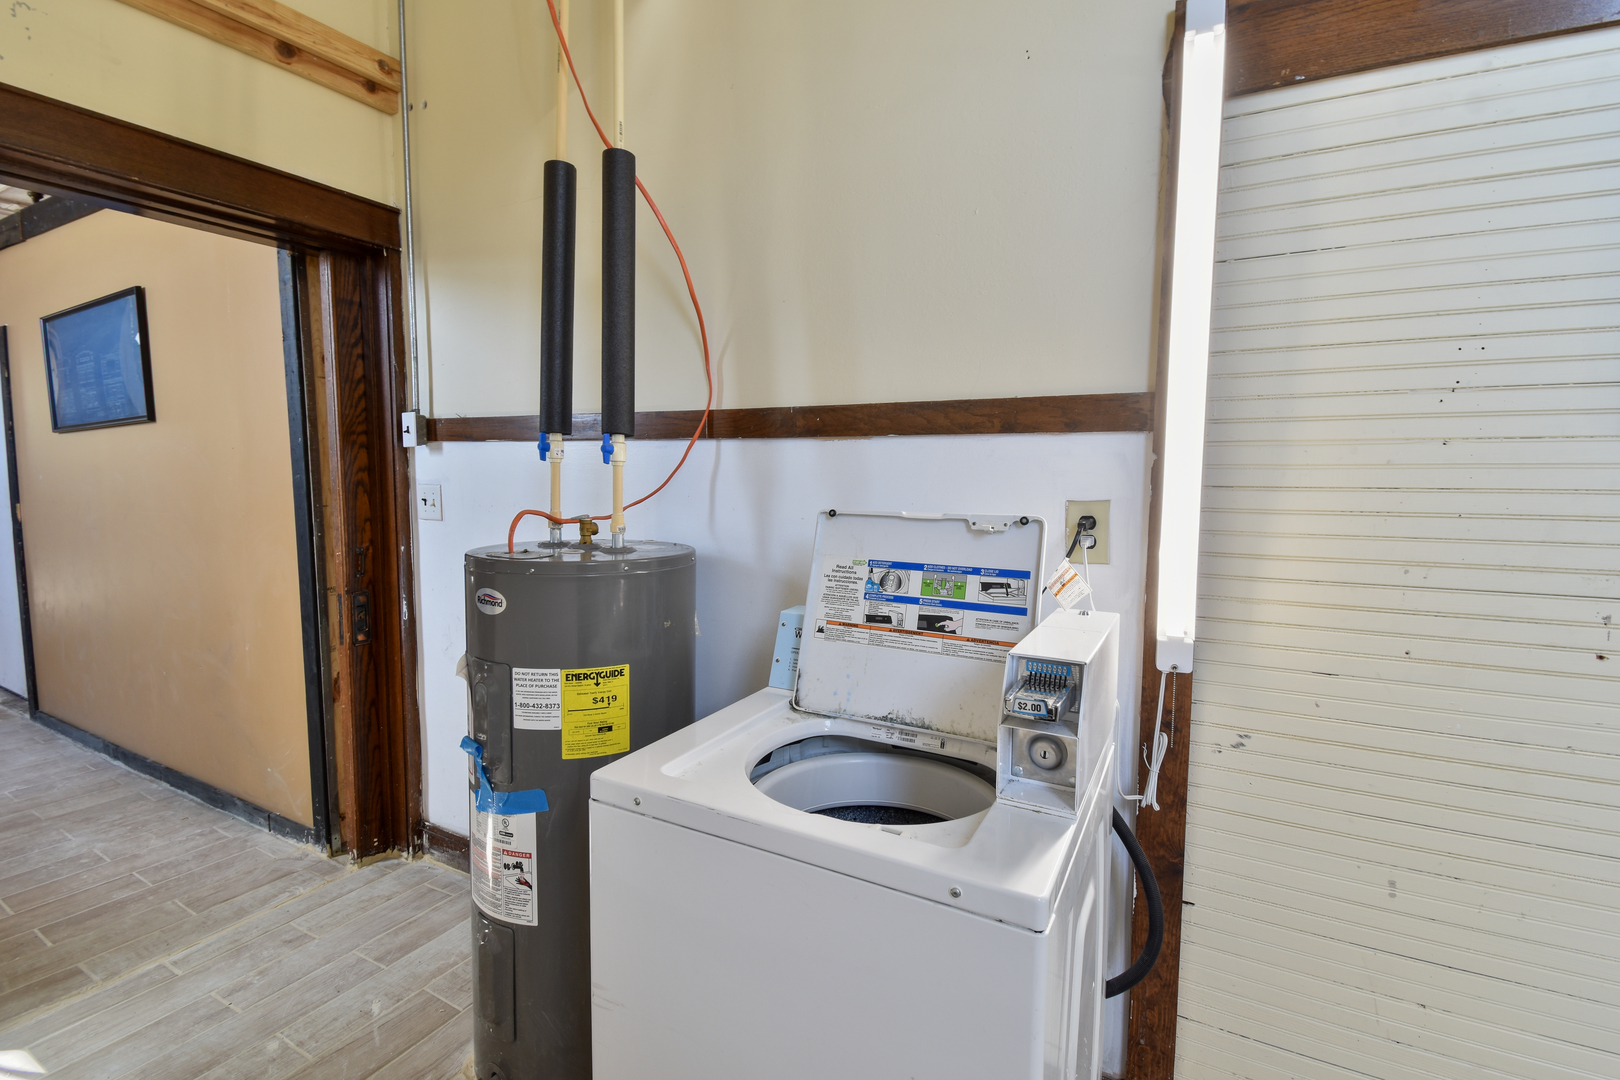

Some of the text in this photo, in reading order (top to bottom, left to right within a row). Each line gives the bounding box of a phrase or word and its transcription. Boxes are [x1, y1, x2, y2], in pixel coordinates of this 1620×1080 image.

[477, 595, 503, 607] Richmond
[565, 668, 625, 682] ENERGYGUIDE
[592, 694, 617, 704] $419
[1017, 701, 1042, 712] $2.00
